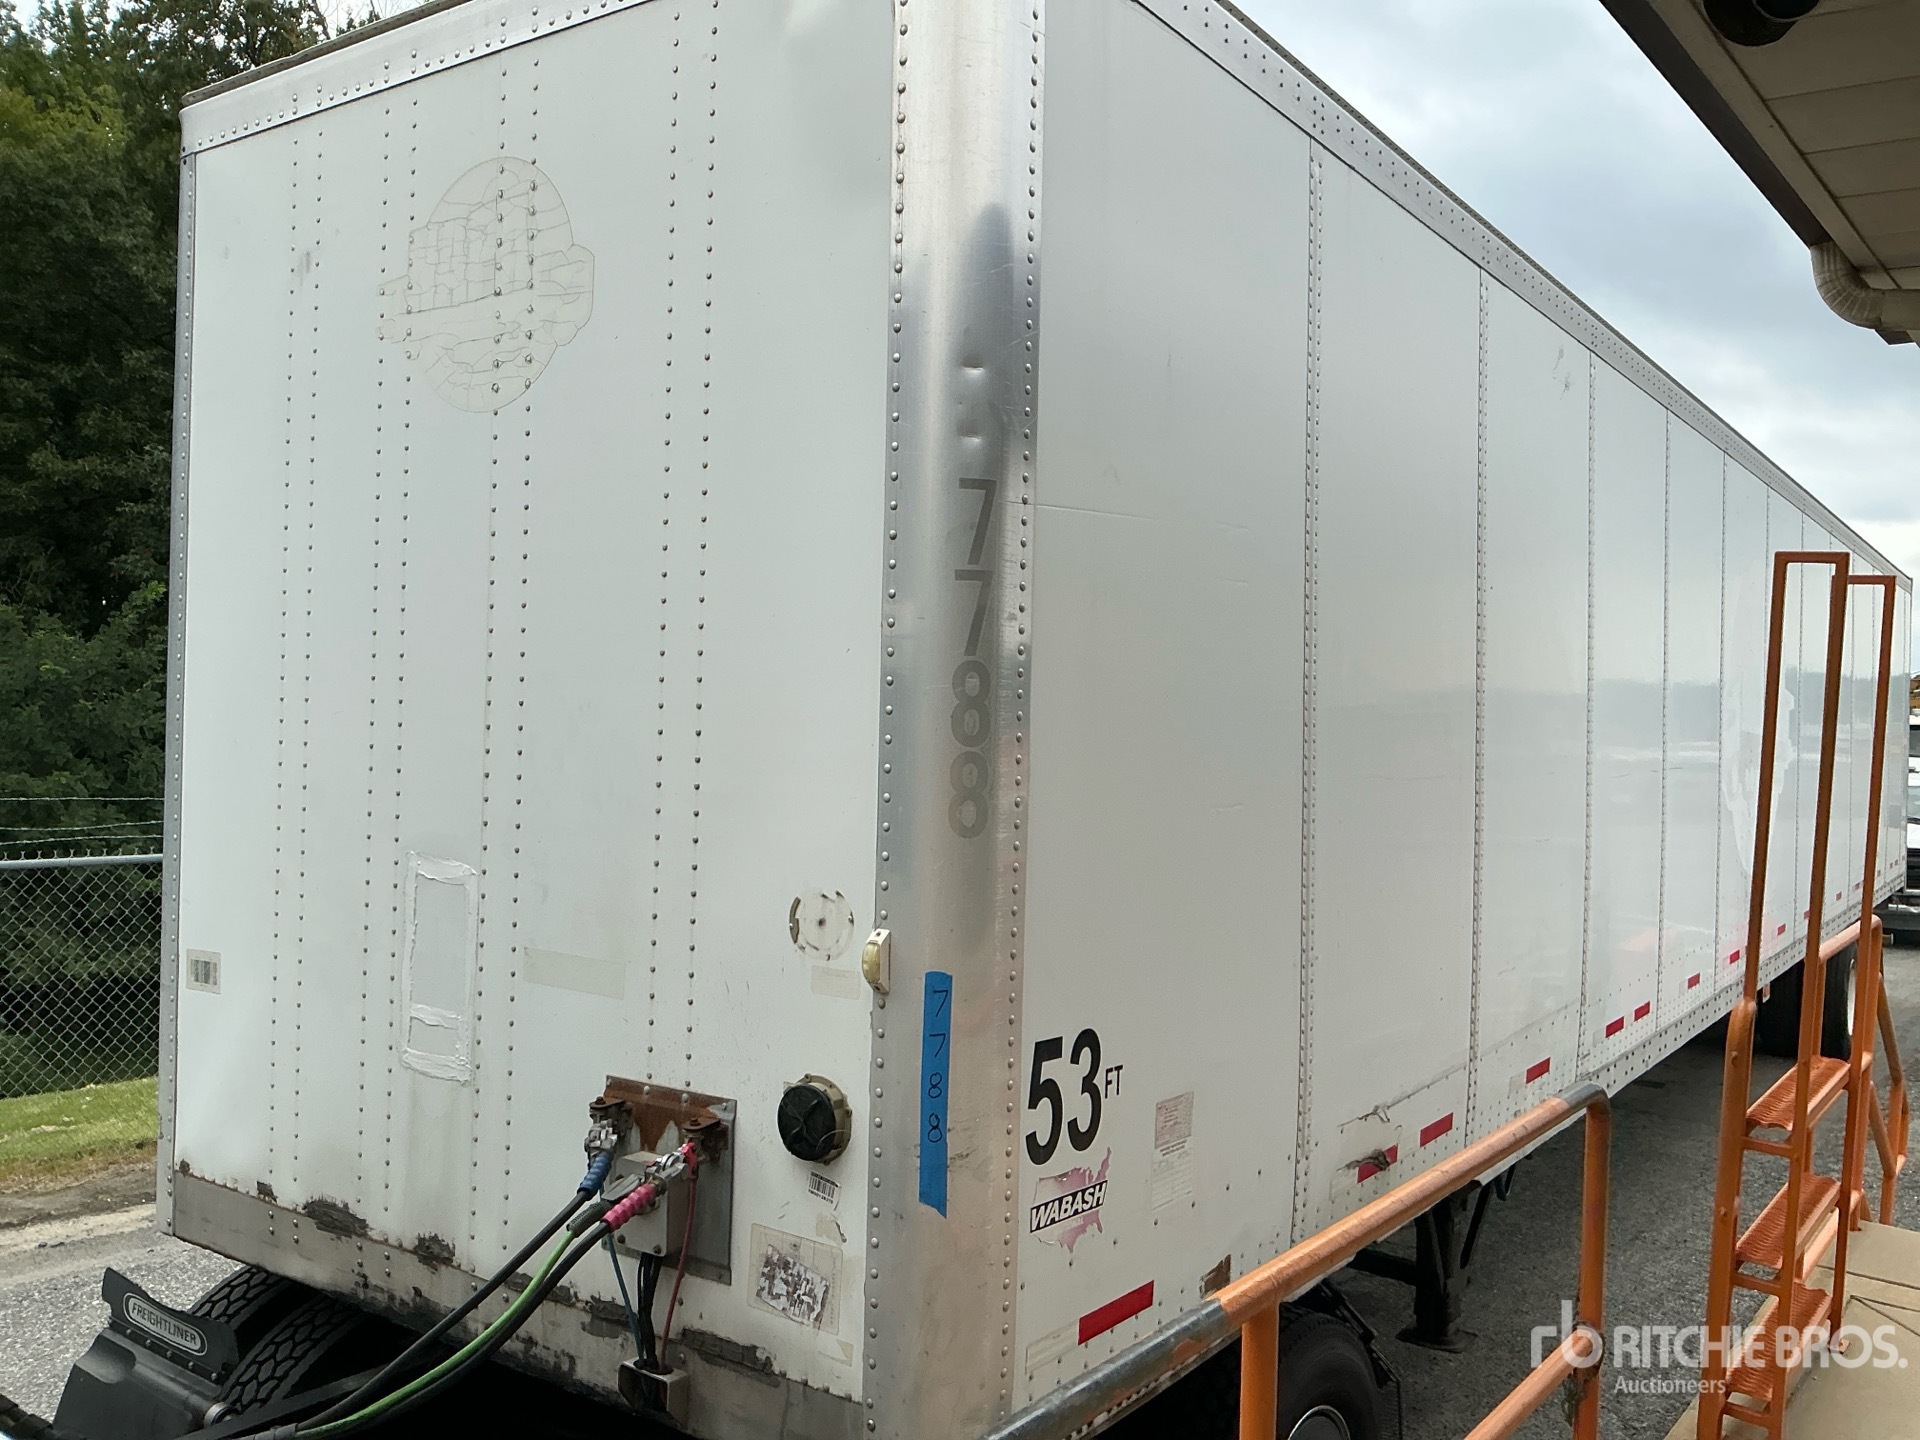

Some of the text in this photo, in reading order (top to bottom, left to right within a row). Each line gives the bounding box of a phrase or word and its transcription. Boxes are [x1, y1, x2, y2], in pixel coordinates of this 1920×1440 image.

[948, 477, 997, 839] 7788
[927, 989, 949, 1144] 7788
[1025, 1028, 1102, 1165] 53
[1105, 1064, 1124, 1099] FT
[1031, 1182, 1107, 1231] WABASH
[131, 1302, 198, 1346] FREIGHTLINER
